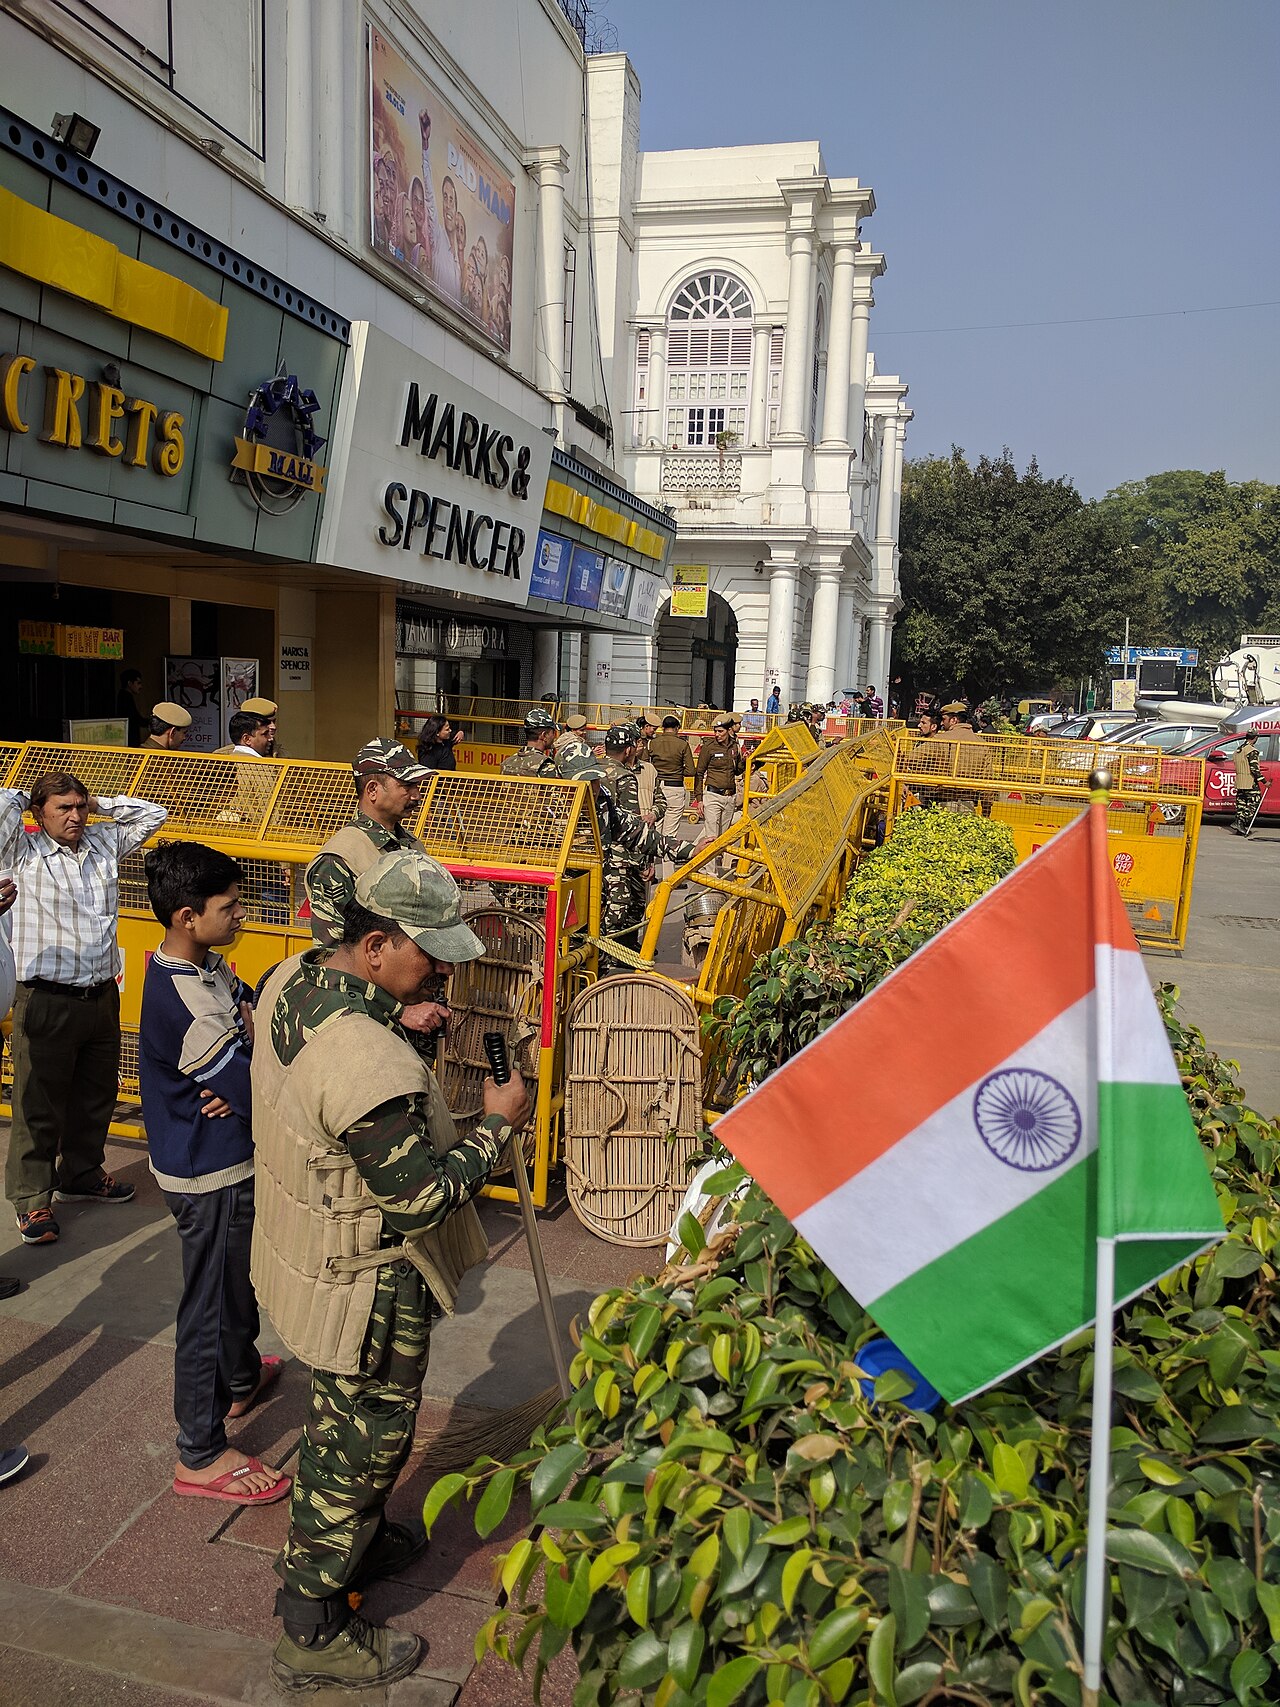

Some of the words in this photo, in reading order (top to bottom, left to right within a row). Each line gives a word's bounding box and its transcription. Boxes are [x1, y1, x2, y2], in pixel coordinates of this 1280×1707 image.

[448, 141, 477, 192] PAD
[399, 381, 514, 490] MARKS
[511, 445, 531, 501] &
[267, 451, 314, 486] MALL
[377, 481, 526, 580] SPENCER
[102, 631, 120, 643] BAR
[408, 617, 443, 645] AMIT
[463, 623, 506, 650] ARORA
[281, 646, 304, 657] MARKS
[303, 647, 309, 657] &
[280, 659, 310, 670] SPENCER
[195, 734, 213, 743] OFF
[455, 749, 474, 764] LHI
[480, 751, 510, 767] POLI
